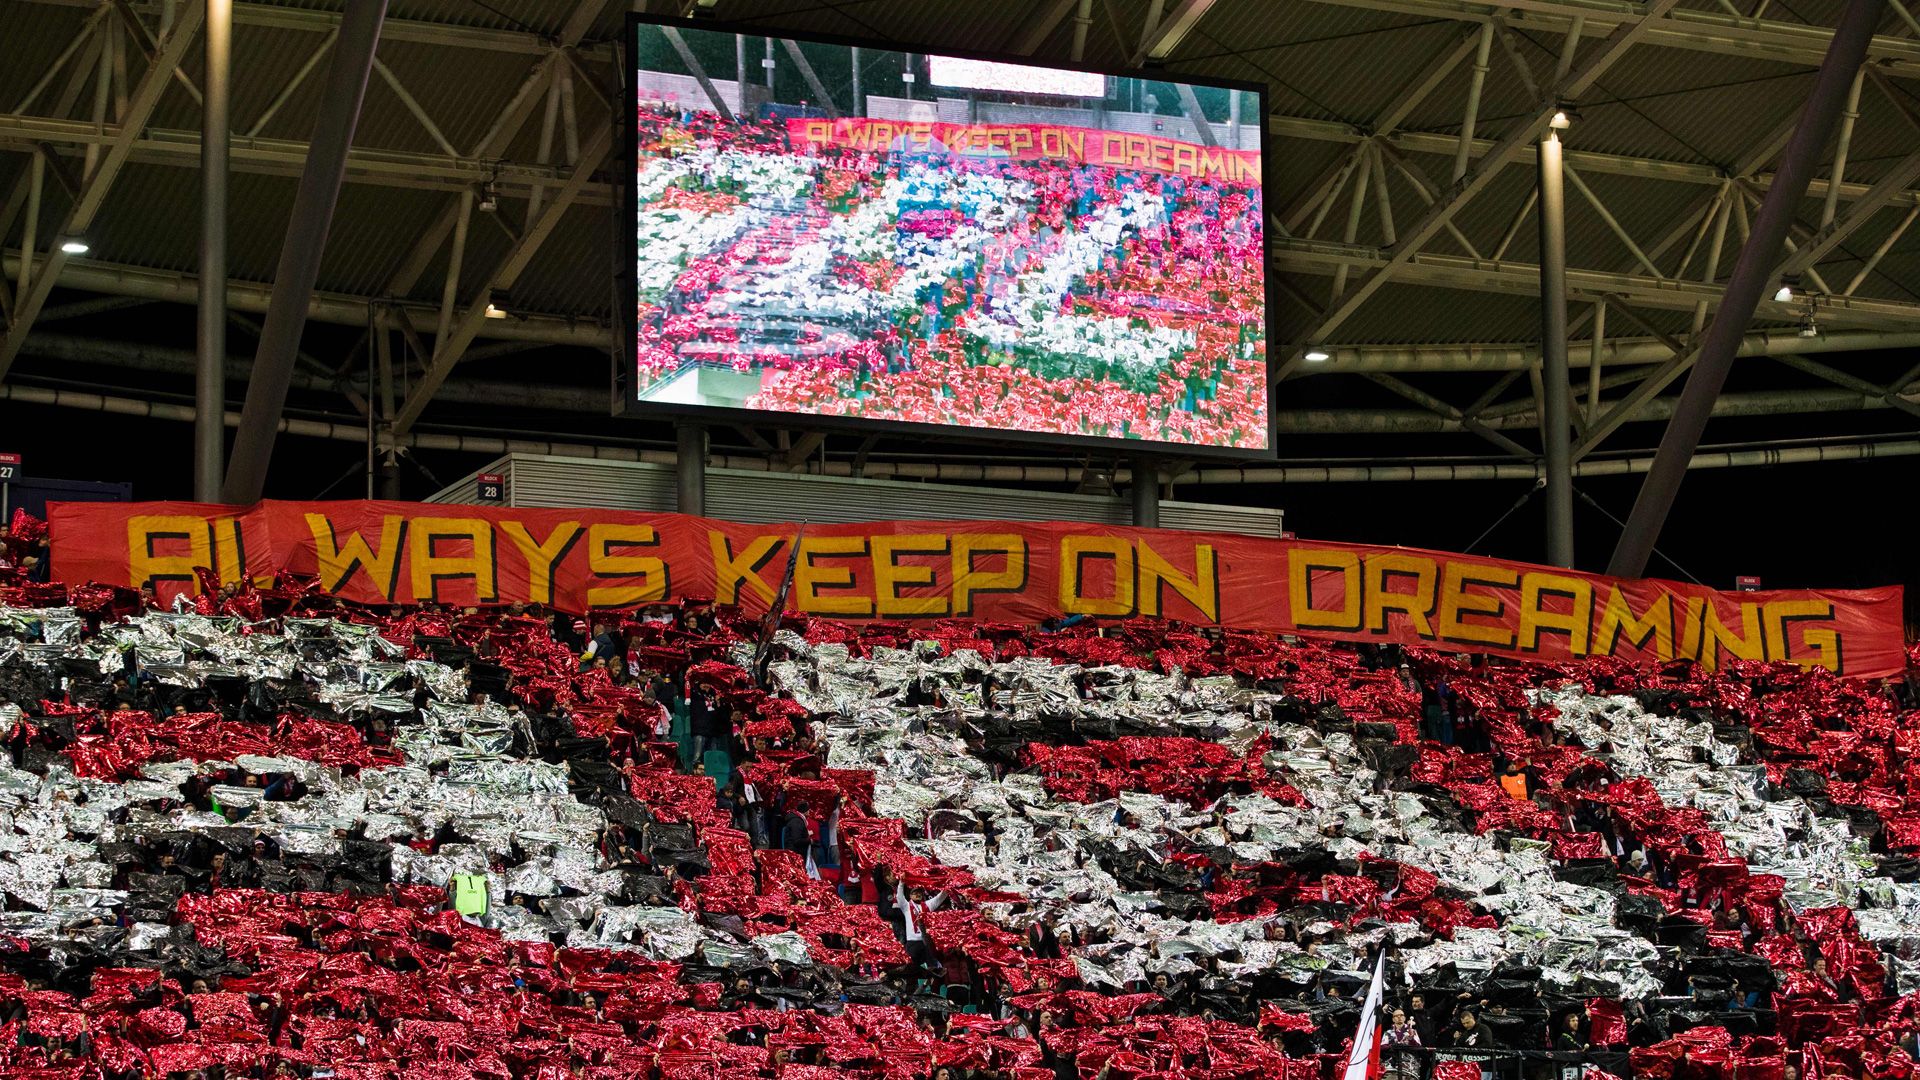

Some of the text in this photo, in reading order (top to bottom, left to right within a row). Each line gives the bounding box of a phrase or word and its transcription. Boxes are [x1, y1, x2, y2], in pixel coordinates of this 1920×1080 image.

[807, 122, 1261, 184] ALWAYS KEEP ON DREAMIN
[0, 467, 13, 478] 27
[485, 486, 497, 497] 28
[126, 513, 1843, 676] ALWAYS KEEP ON DREAMING
